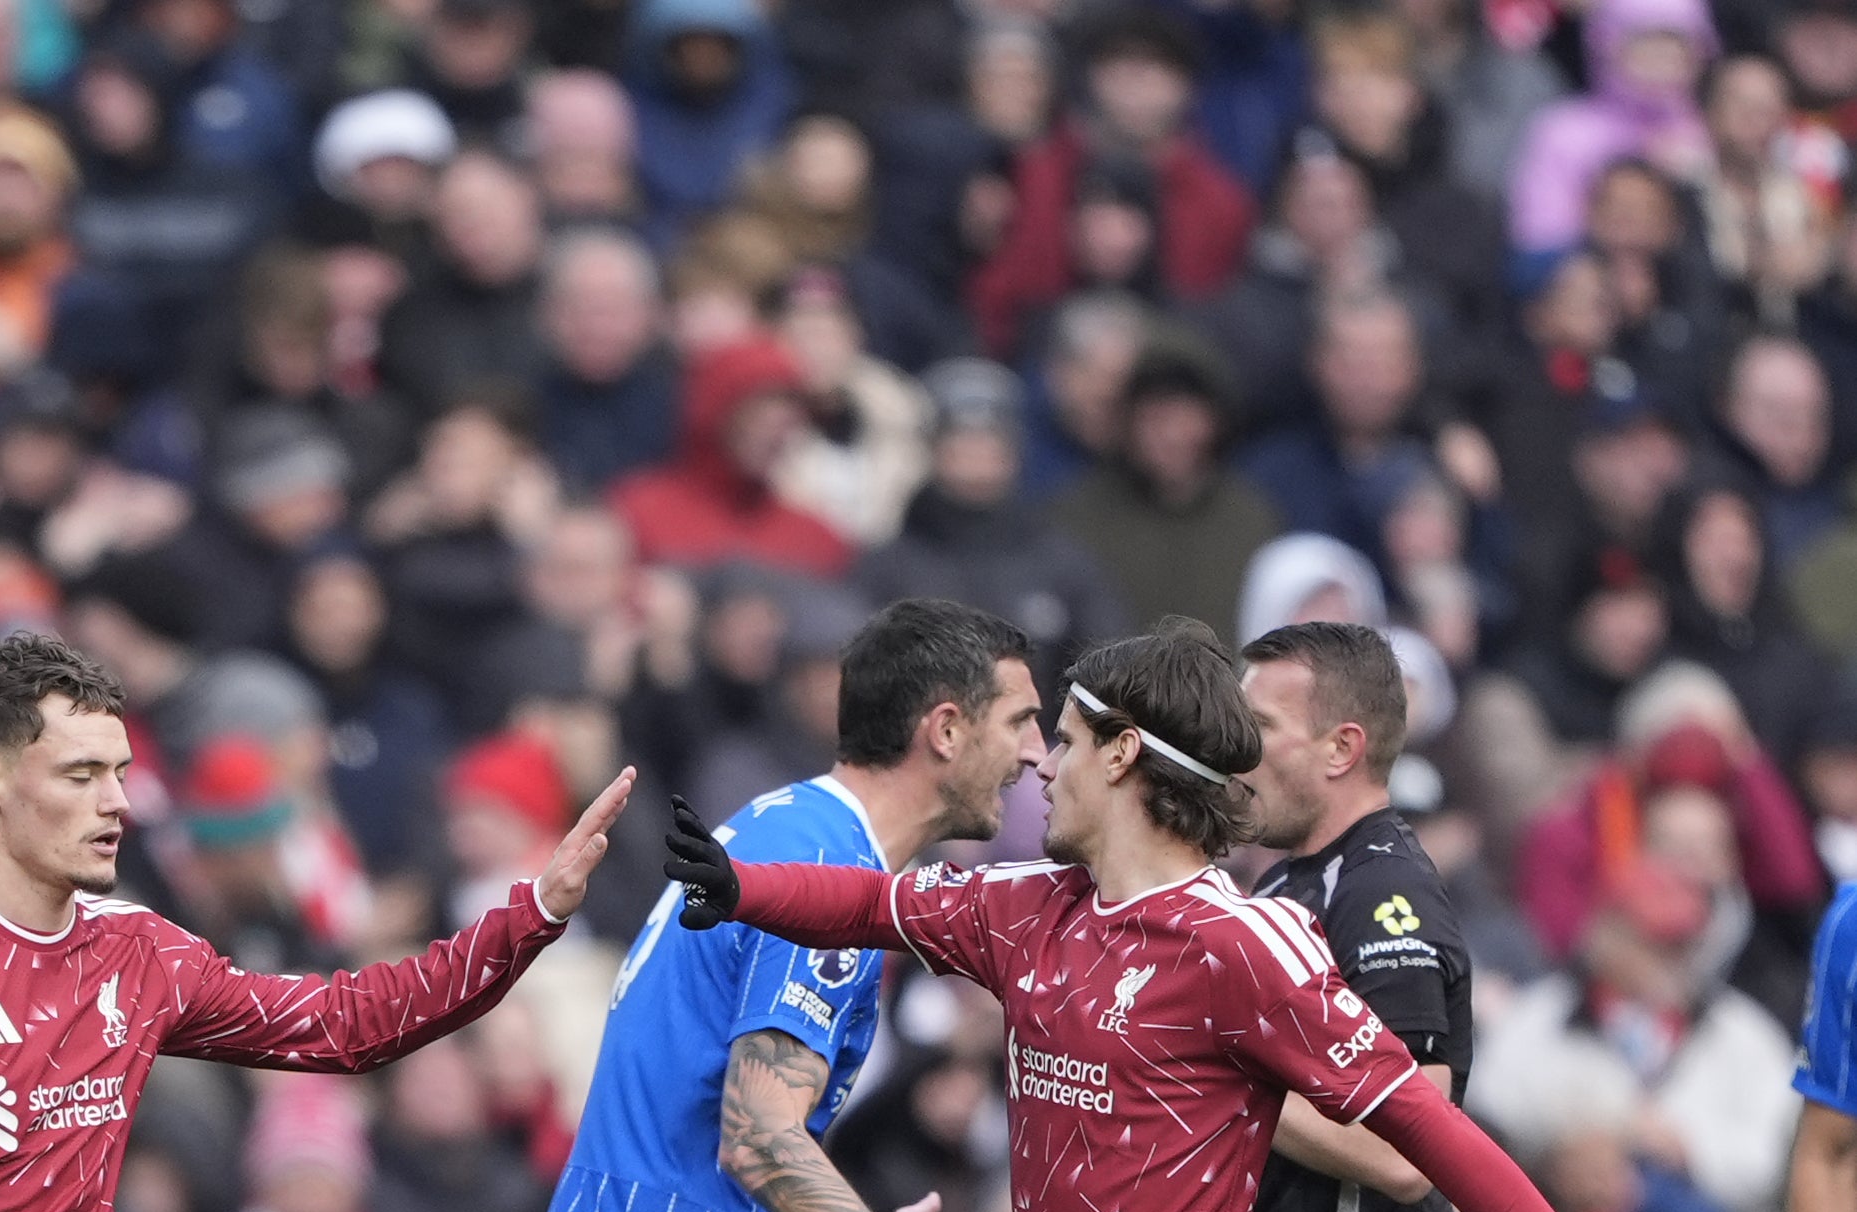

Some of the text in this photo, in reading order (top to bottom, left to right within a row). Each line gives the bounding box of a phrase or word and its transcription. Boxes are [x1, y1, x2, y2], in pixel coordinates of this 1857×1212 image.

[805, 990, 832, 1018] room
[1327, 1007, 1383, 1069] Expe
[1022, 1044, 1108, 1087] standard
[28, 1071, 127, 1112] standard
[1022, 1071, 1114, 1115] chartered
[26, 1094, 128, 1133] chartered
